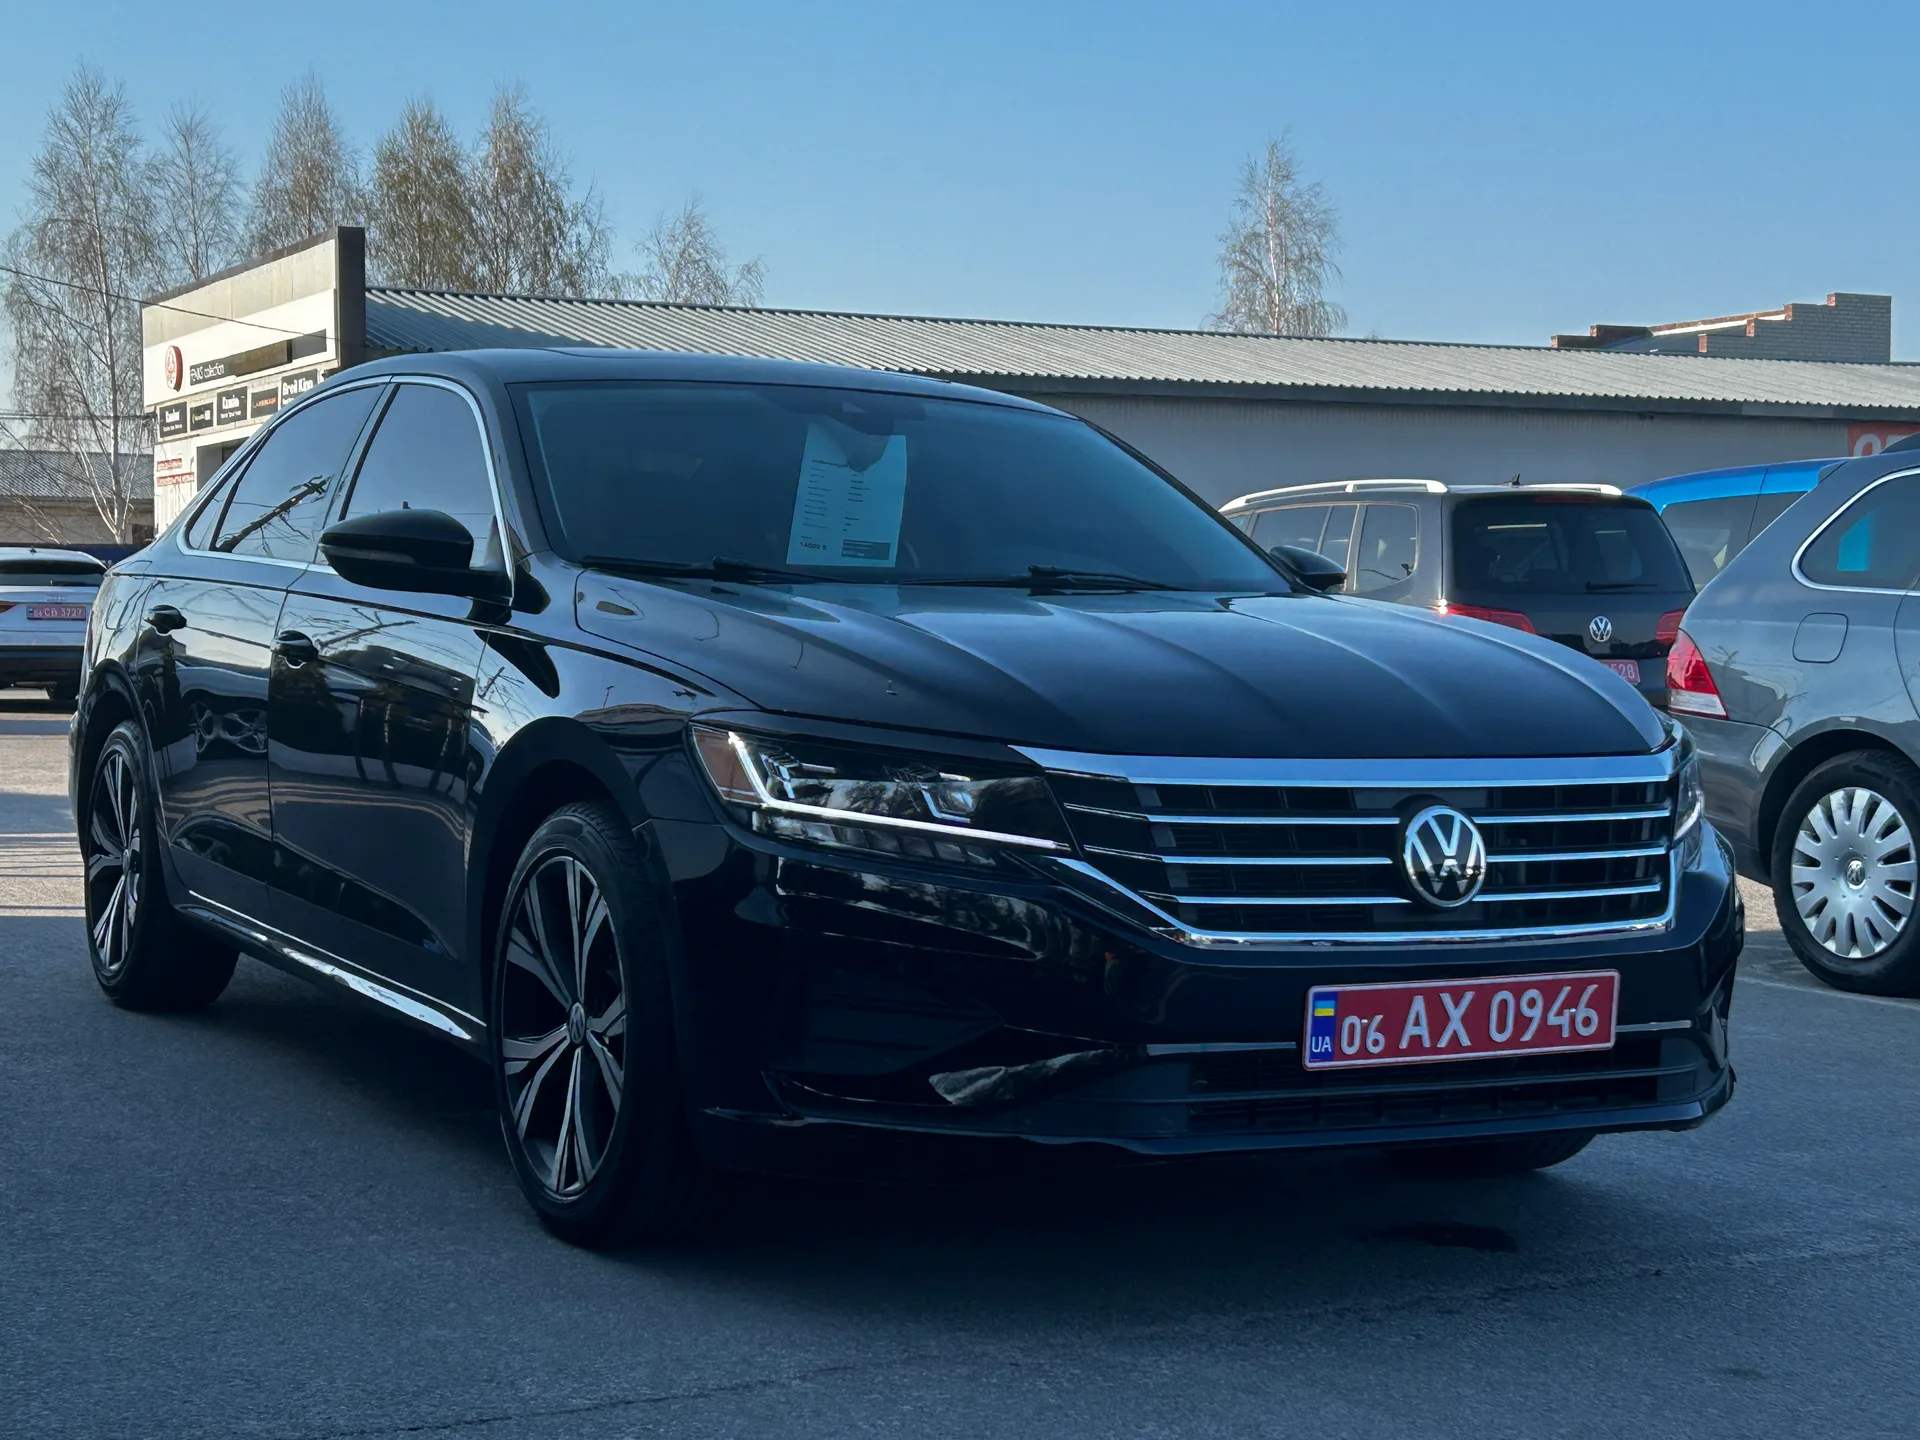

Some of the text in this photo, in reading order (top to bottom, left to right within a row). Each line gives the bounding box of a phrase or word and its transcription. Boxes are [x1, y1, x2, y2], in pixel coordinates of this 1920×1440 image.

[1404, 806, 1486, 907] VW
[1311, 1036, 1333, 1053] UA
[1340, 984, 1599, 1055] 06 AX 0946
